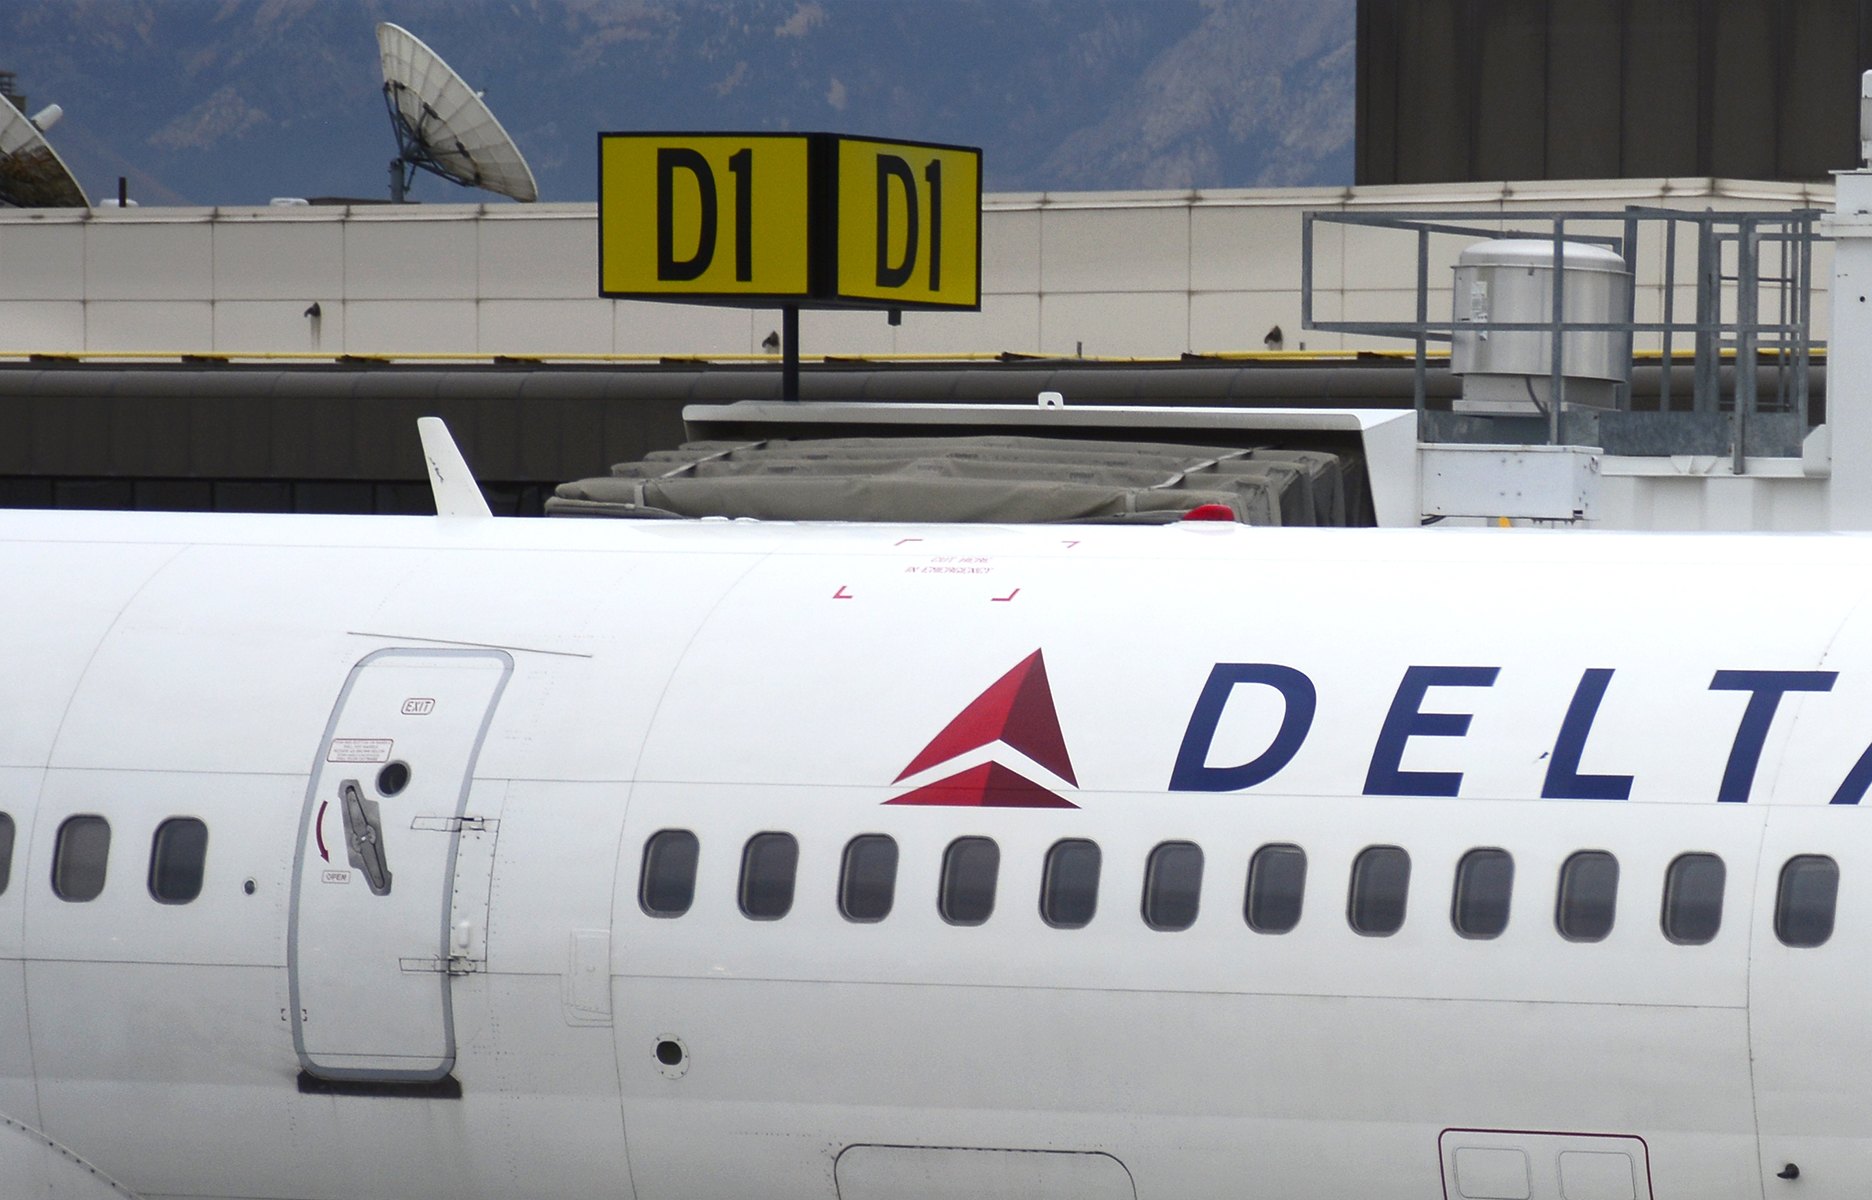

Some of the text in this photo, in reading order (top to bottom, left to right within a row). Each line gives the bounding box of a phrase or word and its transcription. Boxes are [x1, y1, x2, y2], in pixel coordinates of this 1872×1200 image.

[658, 148, 752, 282] D1
[876, 153, 941, 291] D1
[405, 701, 432, 712] EXIT
